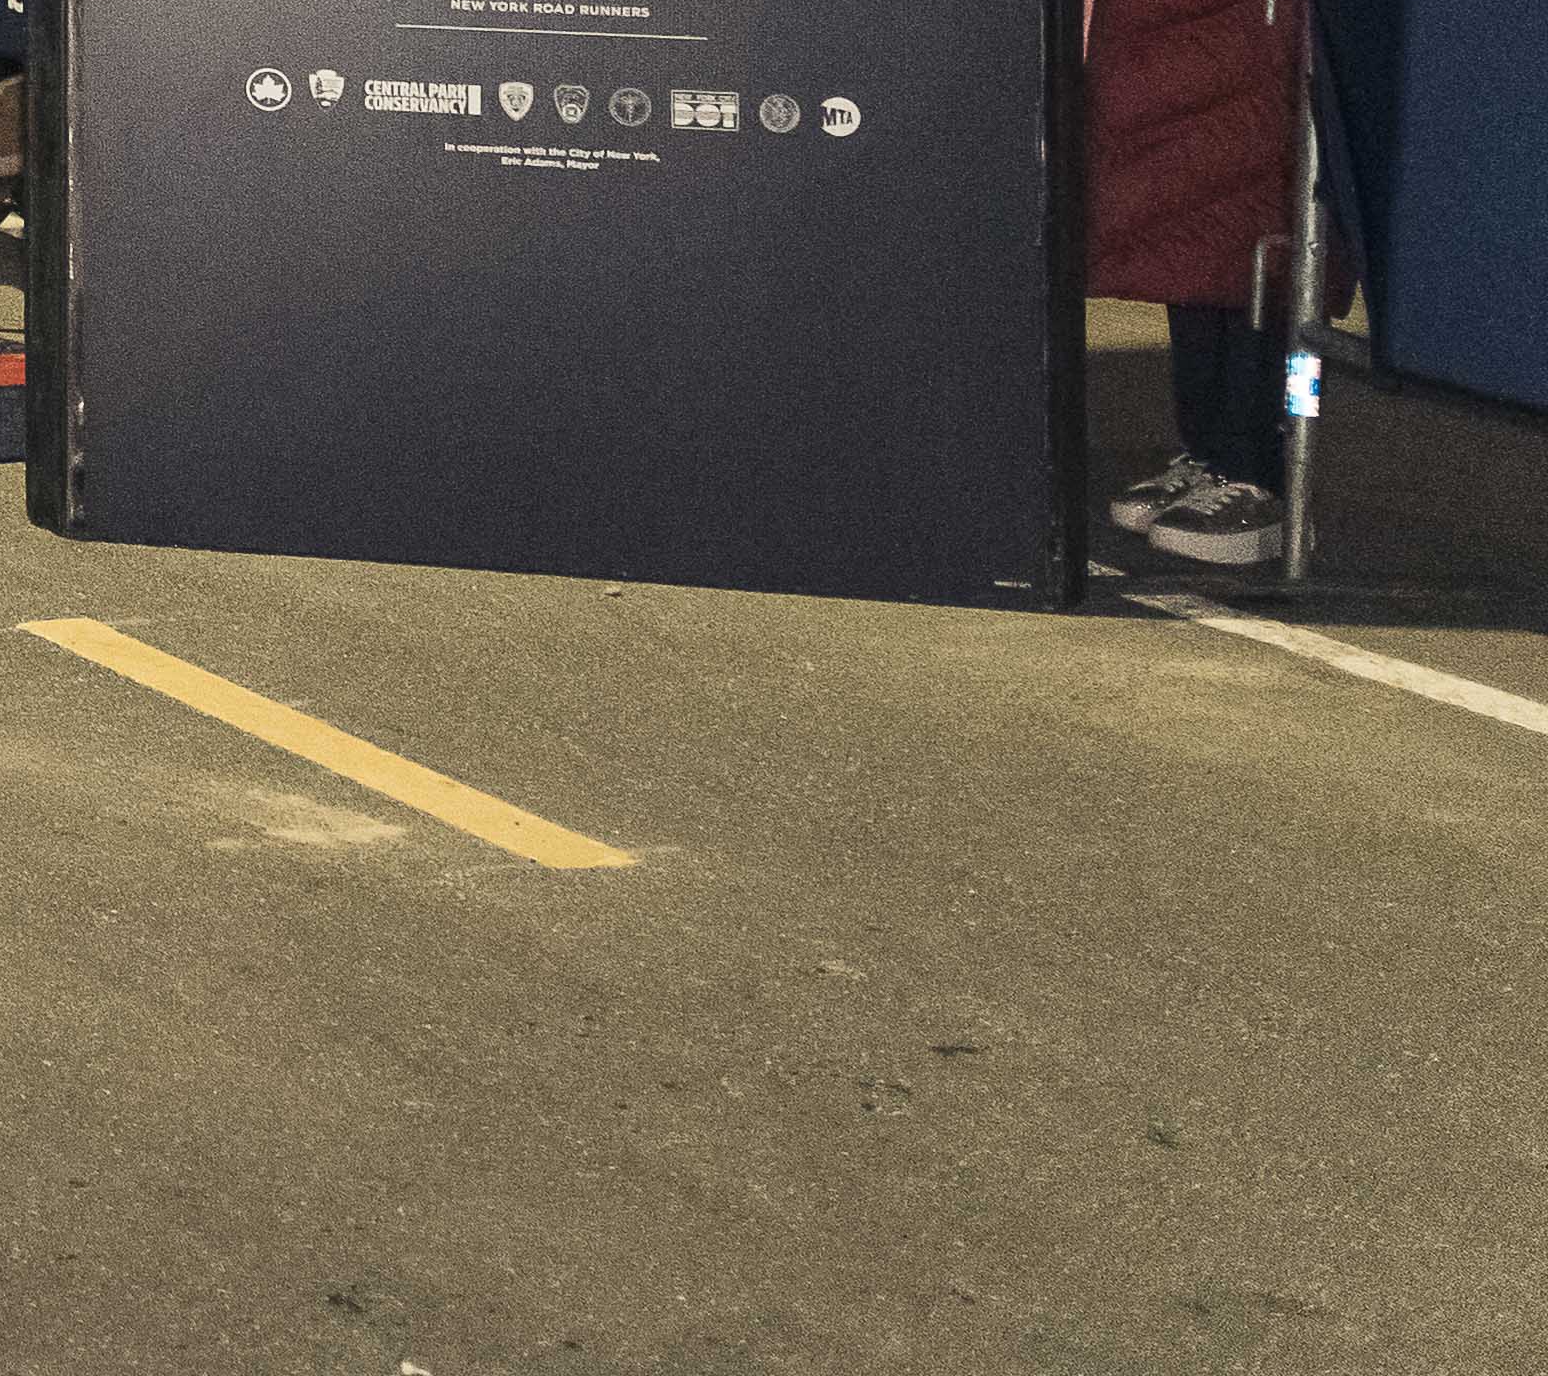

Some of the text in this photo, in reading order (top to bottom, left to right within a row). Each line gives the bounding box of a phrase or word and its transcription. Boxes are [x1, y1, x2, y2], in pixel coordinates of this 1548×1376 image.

[450, 0, 650, 18] NEW YORK ROAD RUNNERS
[364, 80, 467, 100] CENTRAL PARK
[364, 95, 467, 115] CONSERVANCY
[568, 149, 592, 160] City
